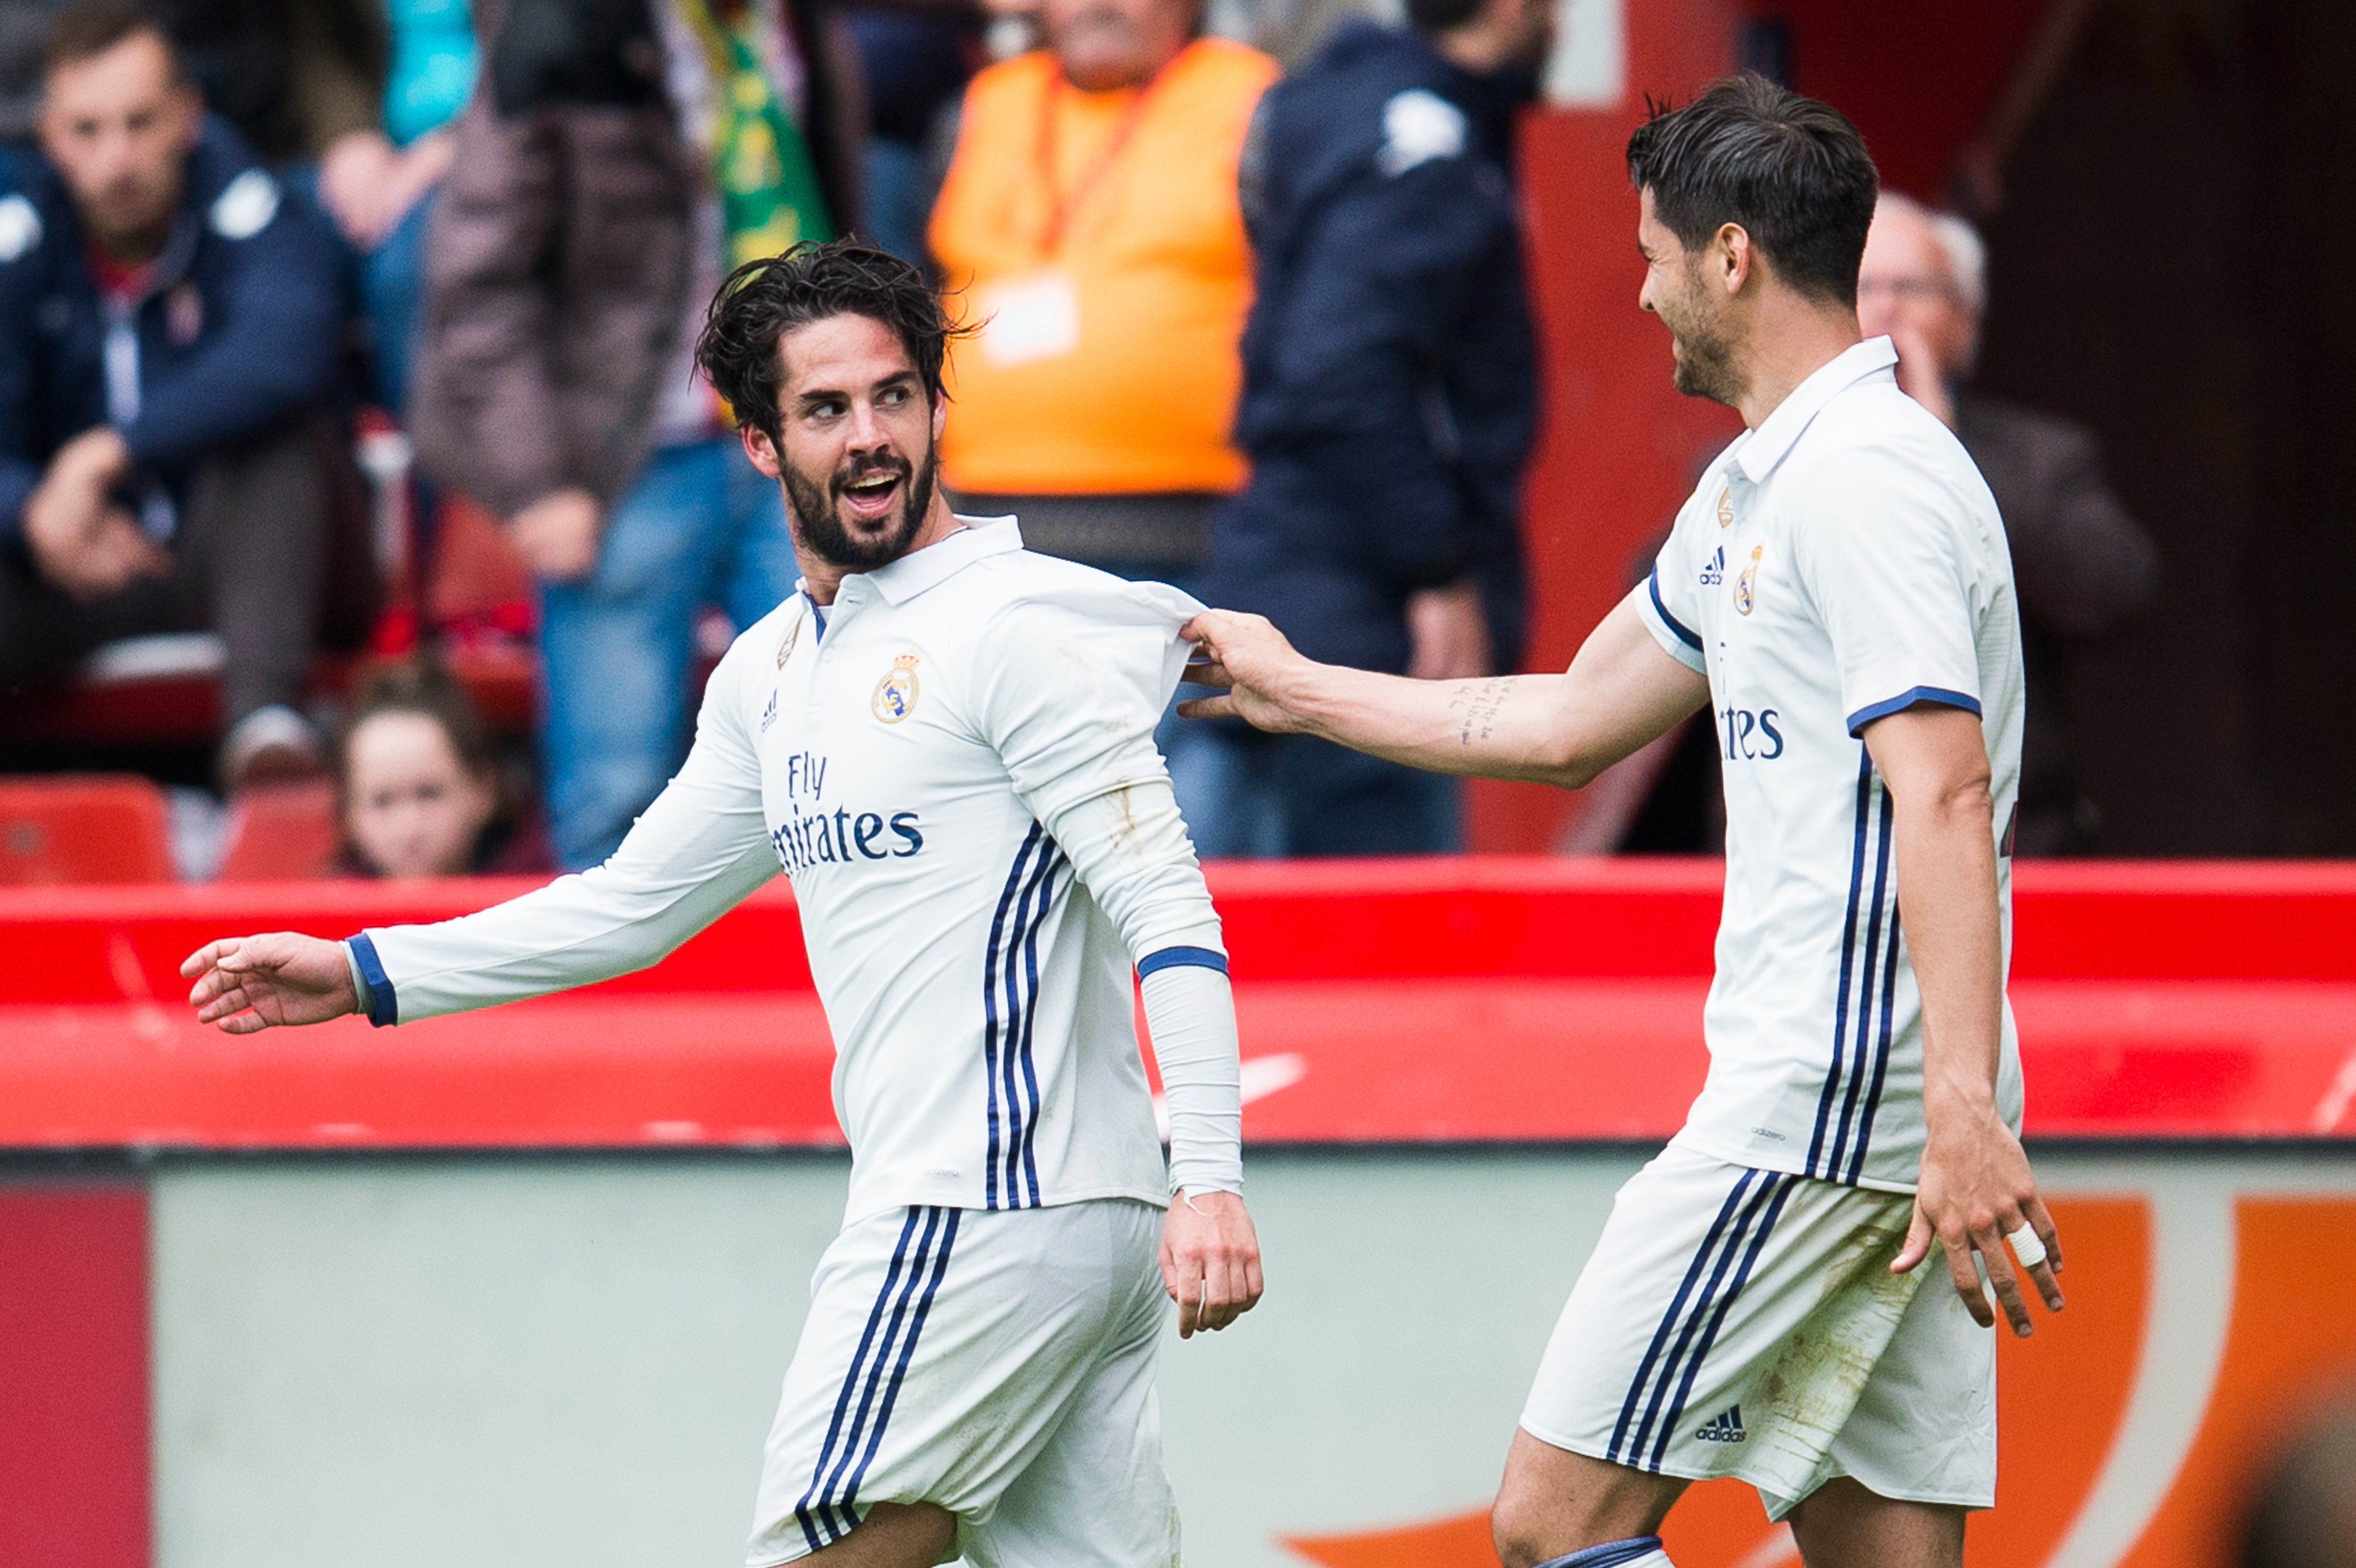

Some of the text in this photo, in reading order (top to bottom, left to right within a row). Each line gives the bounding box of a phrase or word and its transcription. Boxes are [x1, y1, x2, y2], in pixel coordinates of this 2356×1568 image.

[788, 751, 826, 801] Fly
[770, 803, 924, 878] mirates
[1696, 1428, 1747, 1442] adidas
